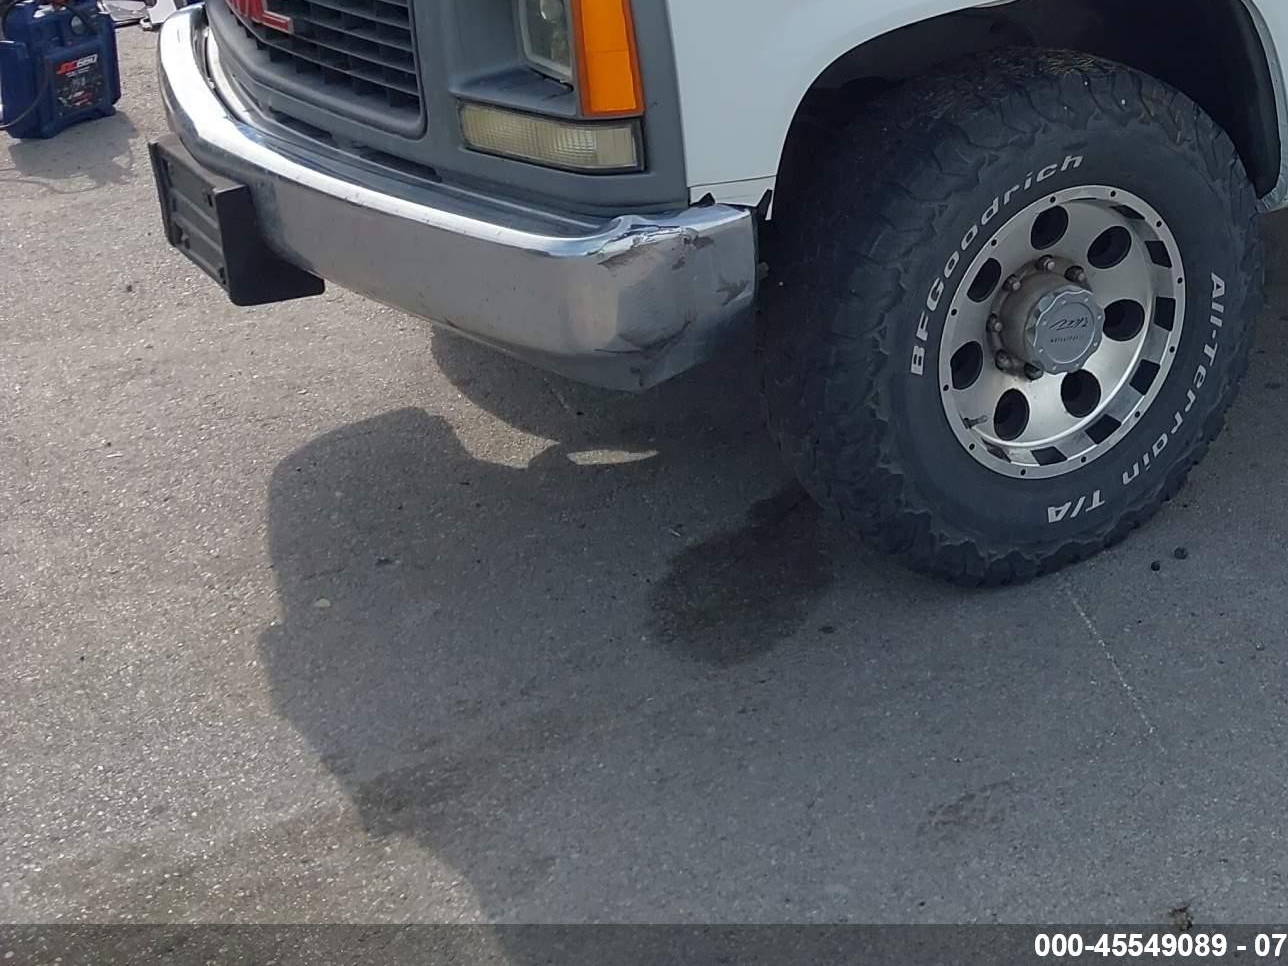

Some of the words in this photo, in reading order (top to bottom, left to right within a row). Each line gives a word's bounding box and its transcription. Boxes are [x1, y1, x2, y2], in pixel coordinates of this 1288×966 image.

[910, 154, 1084, 376] BFGoodrich
[1122, 272, 1227, 486] All-Terrain
[1047, 489, 1106, 524] T/A
